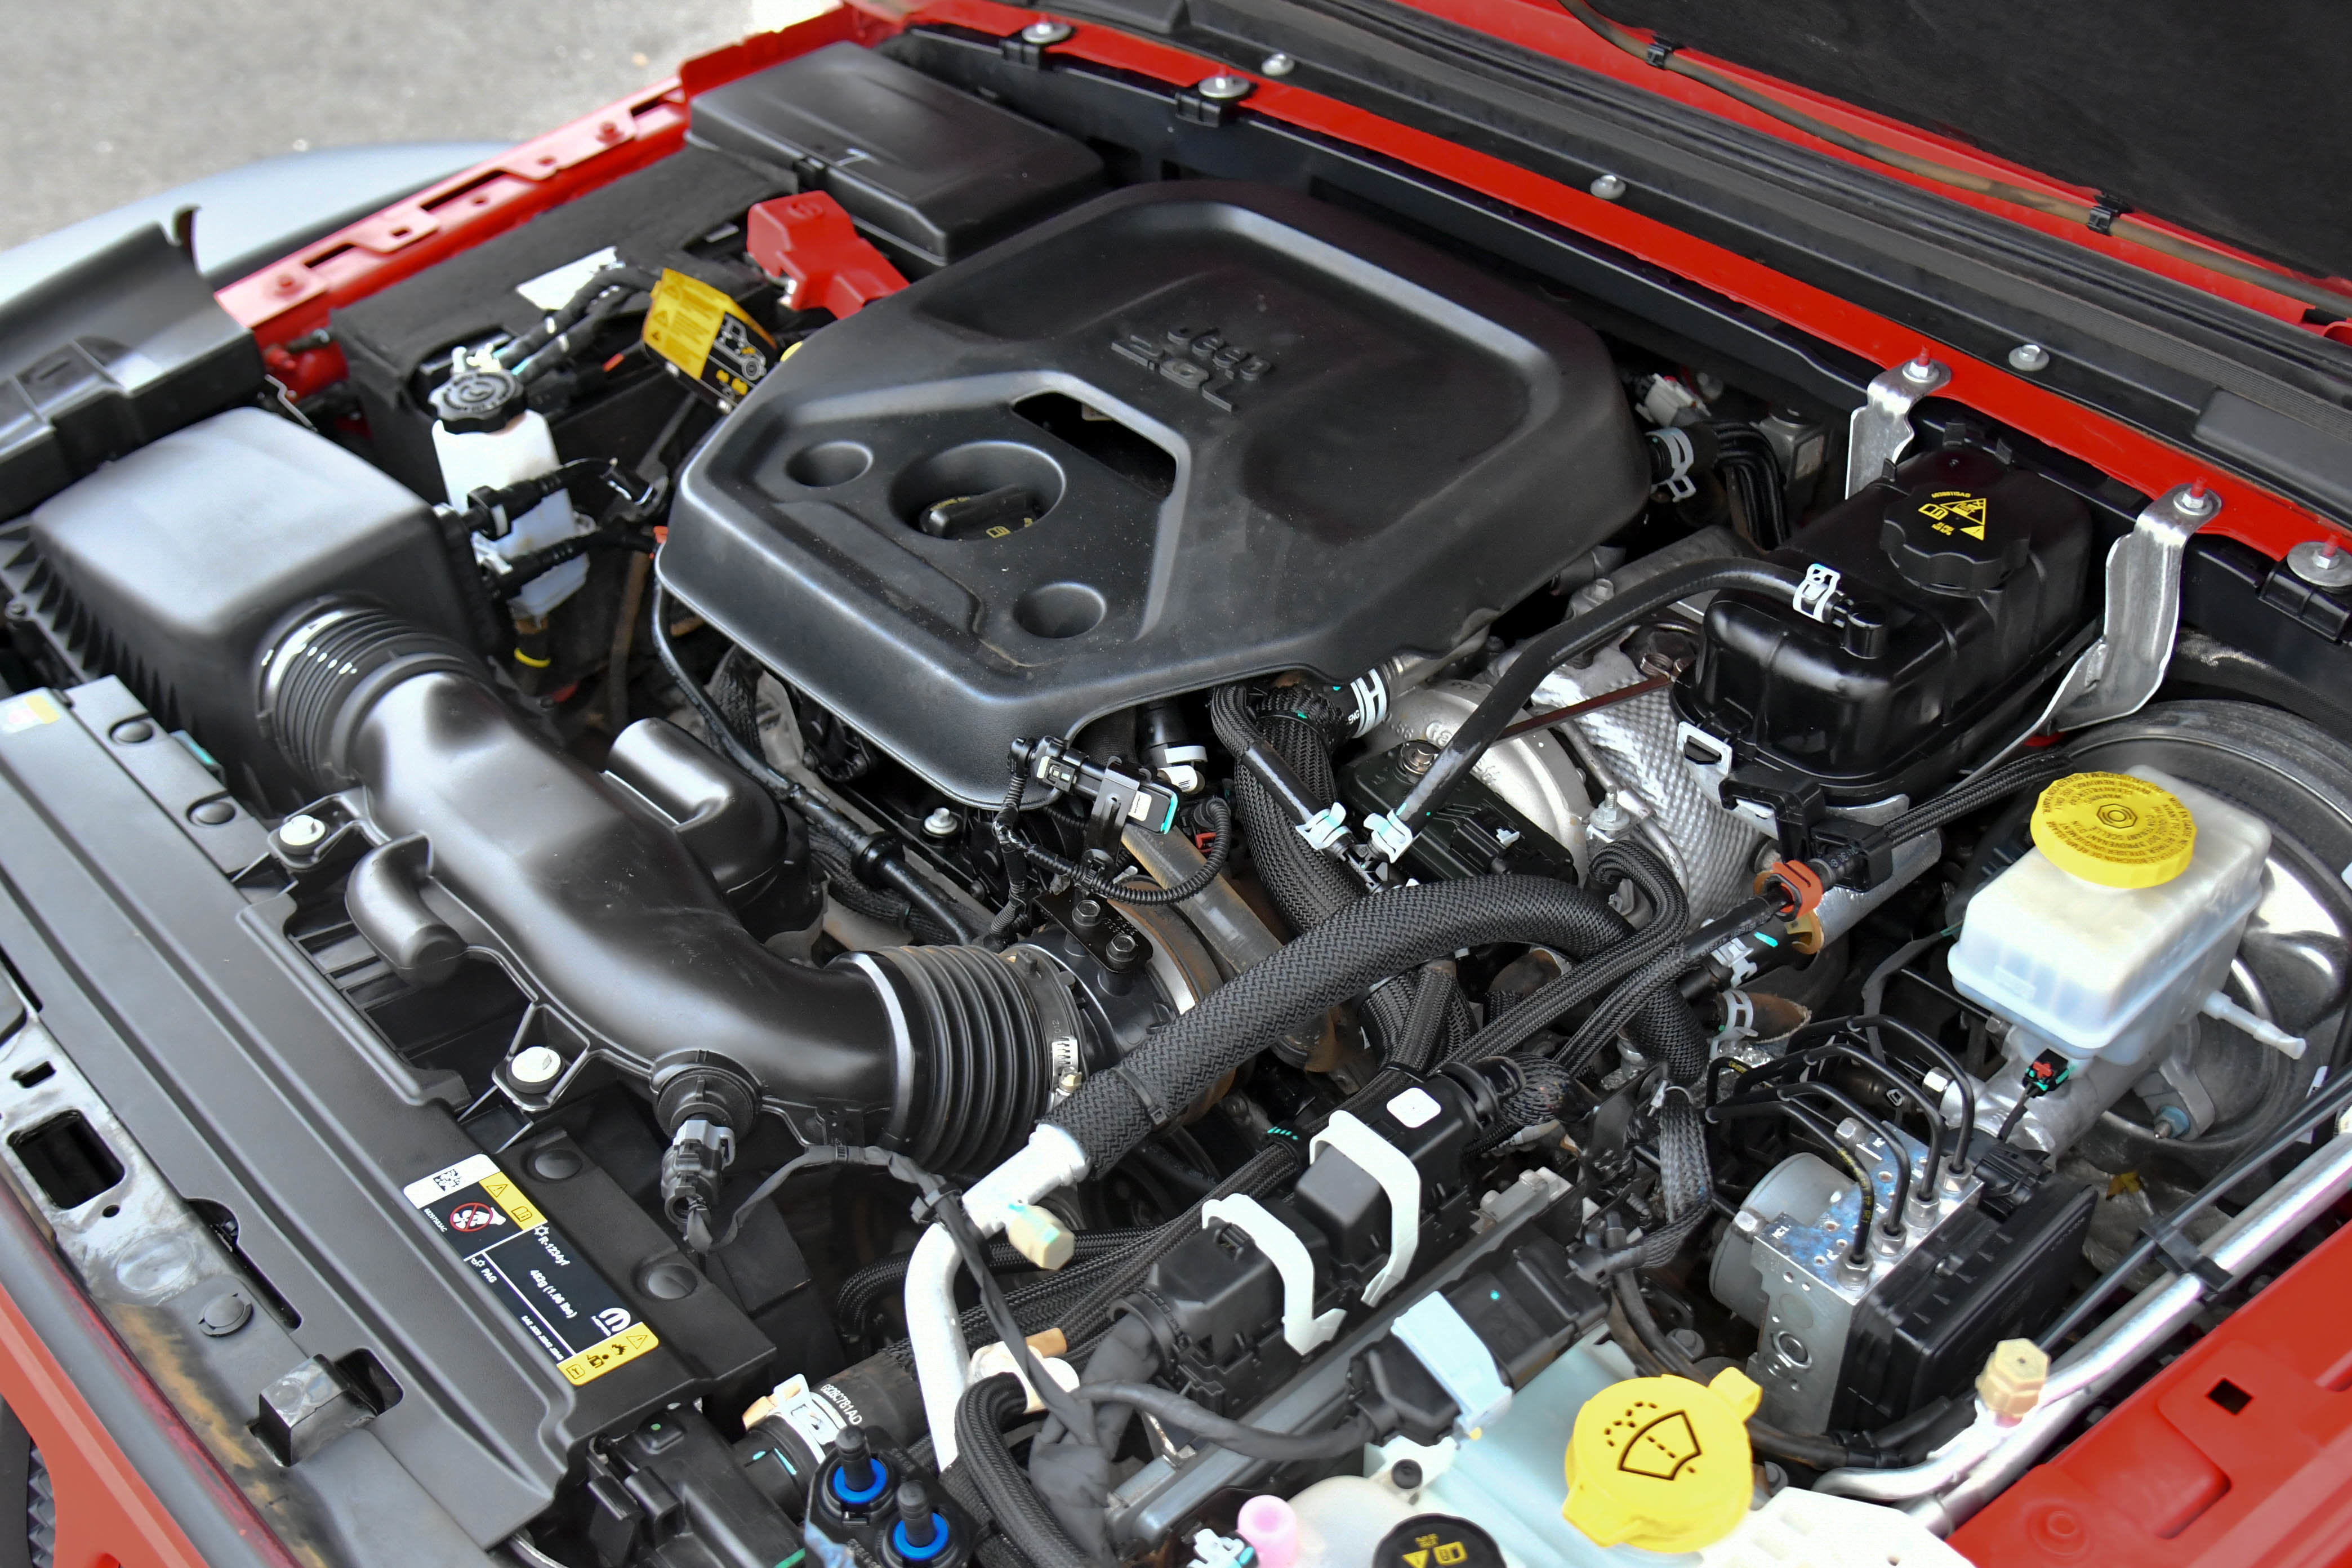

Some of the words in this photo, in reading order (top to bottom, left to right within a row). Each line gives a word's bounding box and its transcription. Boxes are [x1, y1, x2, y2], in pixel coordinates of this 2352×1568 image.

[1166, 323, 1272, 382] Jeep
[2069, 795, 2081, 805] CAP
[538, 1236, 571, 1266] R-1234yf
[480, 1268, 497, 1283] PAG
